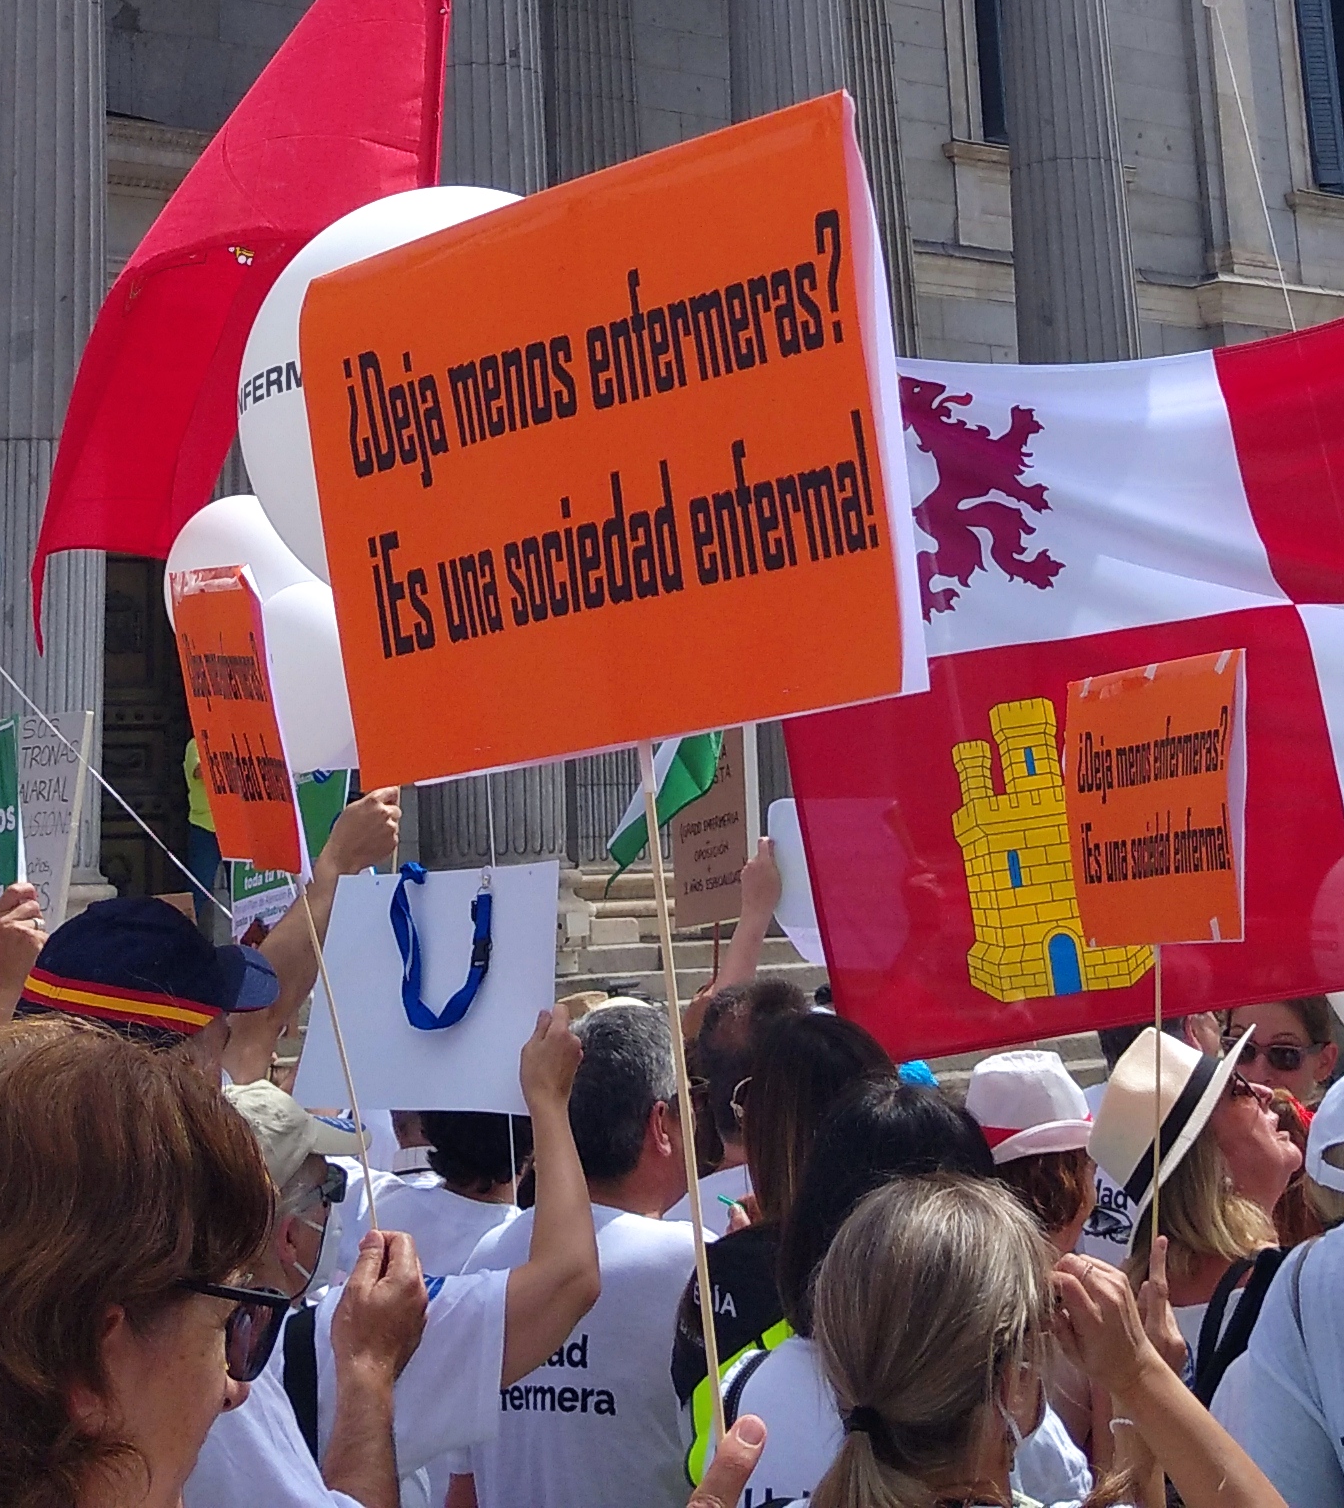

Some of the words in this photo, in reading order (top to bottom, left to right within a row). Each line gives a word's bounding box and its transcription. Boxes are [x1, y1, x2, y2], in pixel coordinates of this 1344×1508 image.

[344, 349, 449, 490] ¿Deja
[448, 334, 578, 449] menos
[587, 208, 845, 412] enfermeras?
[367, 530, 436, 660] ¡Es
[438, 549, 505, 643] una
[507, 462, 685, 628] sociedad
[690, 410, 881, 586] enferma!
[1077, 731, 1114, 805] ¿Deja
[1115, 741, 1152, 789] menos
[1153, 705, 1229, 782] enfermeras?
[1104, 839, 1128, 883] una
[1173, 802, 1232, 874] enferma!
